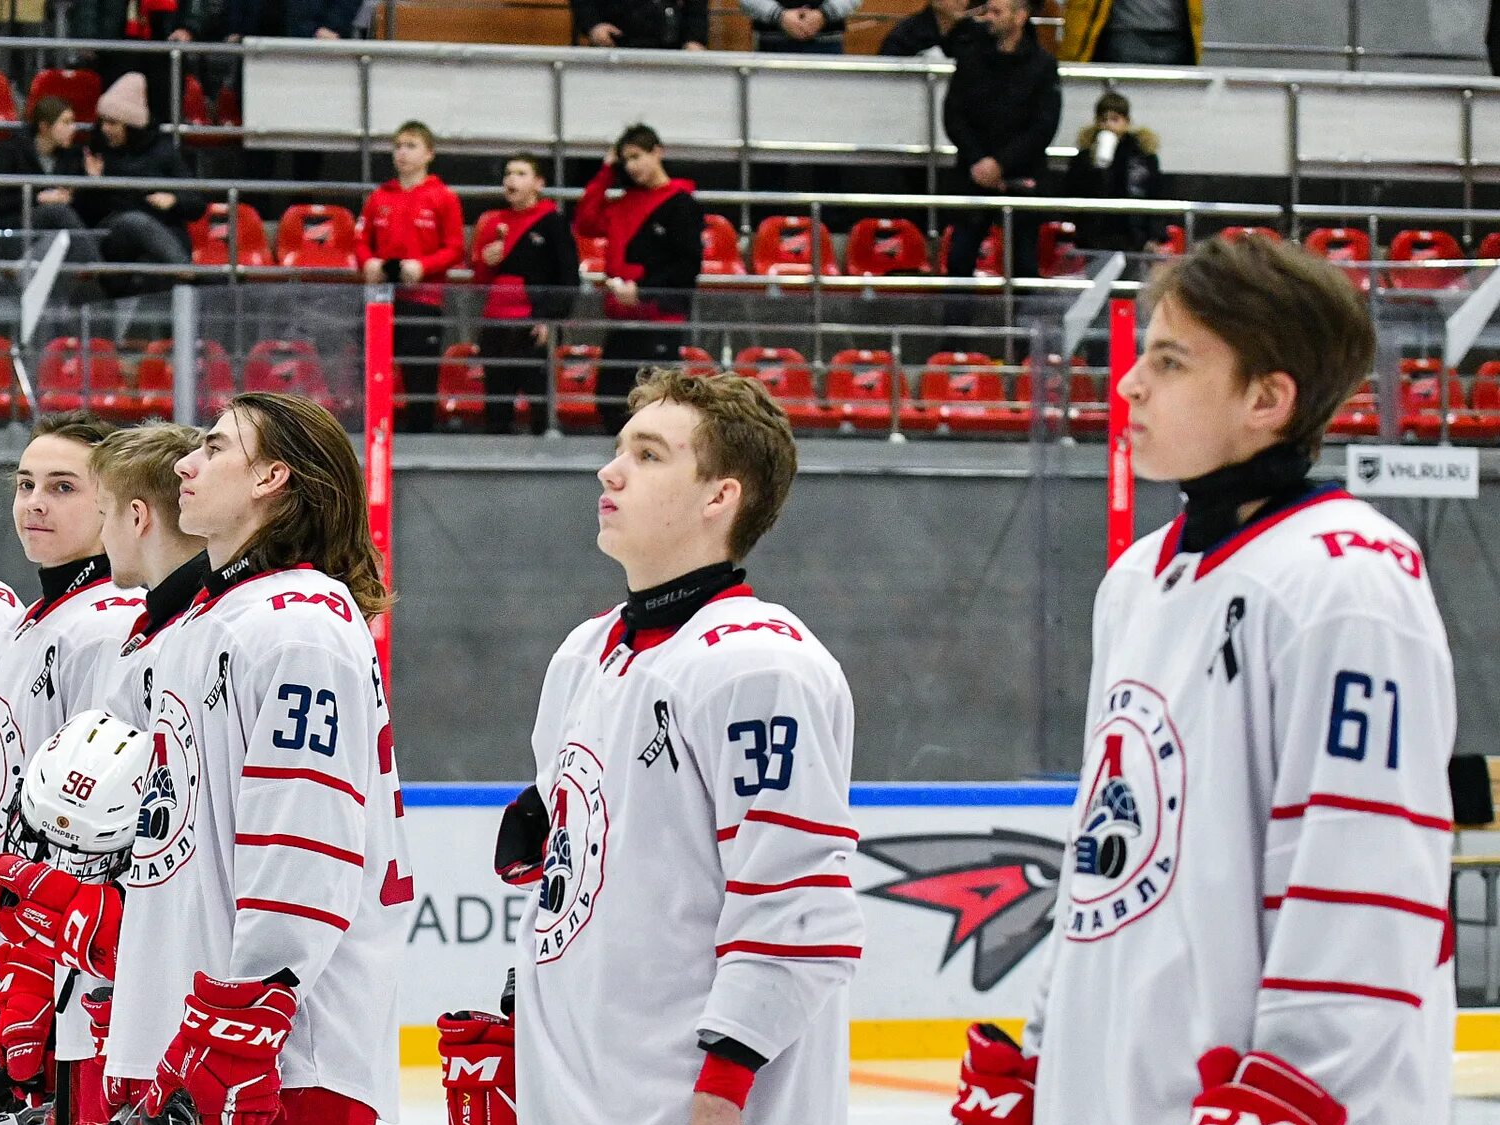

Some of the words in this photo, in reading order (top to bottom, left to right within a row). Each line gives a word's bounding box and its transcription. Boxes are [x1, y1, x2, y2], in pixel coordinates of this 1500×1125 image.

[272, 684, 338, 757] 33
[1327, 670, 1399, 769] 61
[727, 715, 798, 797] 38
[63, 770, 97, 801] 98
[7, 1047, 33, 1060] CCM
[182, 1004, 287, 1048] CCM
